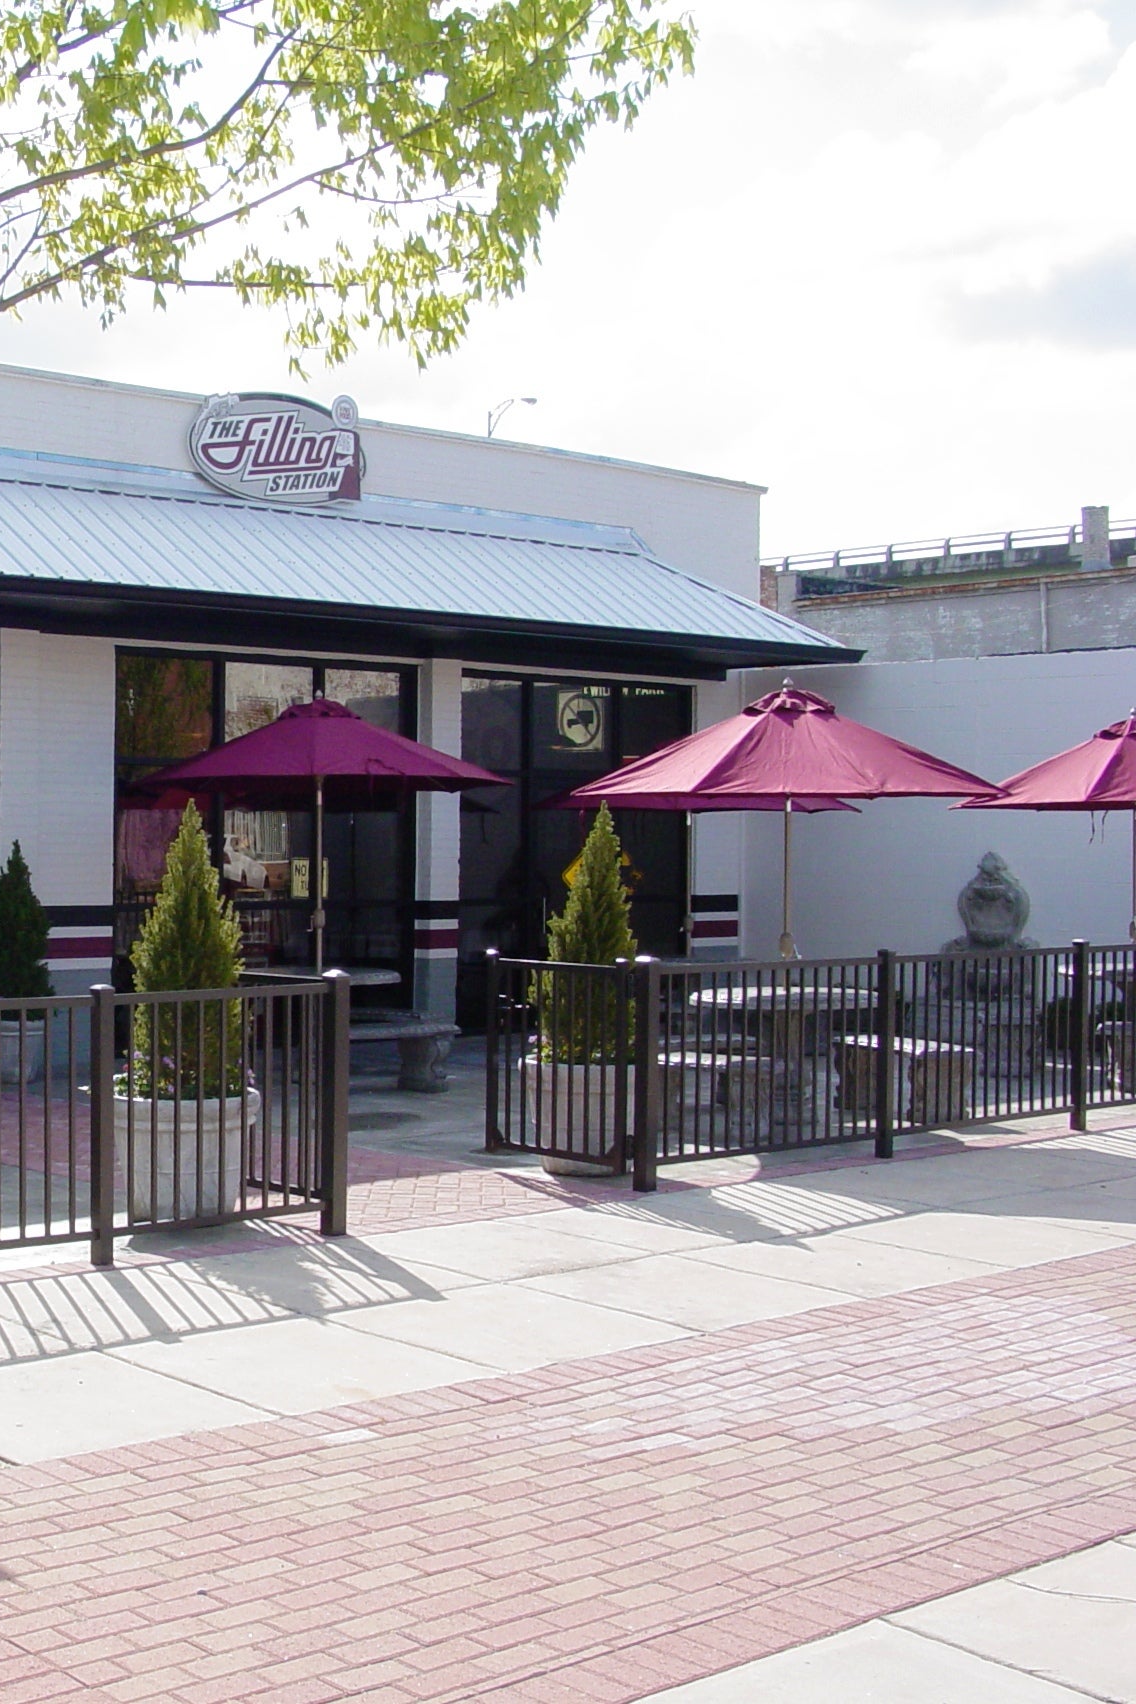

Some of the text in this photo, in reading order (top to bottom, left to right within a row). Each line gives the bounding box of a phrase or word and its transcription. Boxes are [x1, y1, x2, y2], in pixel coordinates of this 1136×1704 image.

[208, 419, 245, 439] THE
[269, 470, 341, 492] STATION
[294, 863, 307, 877] NO
